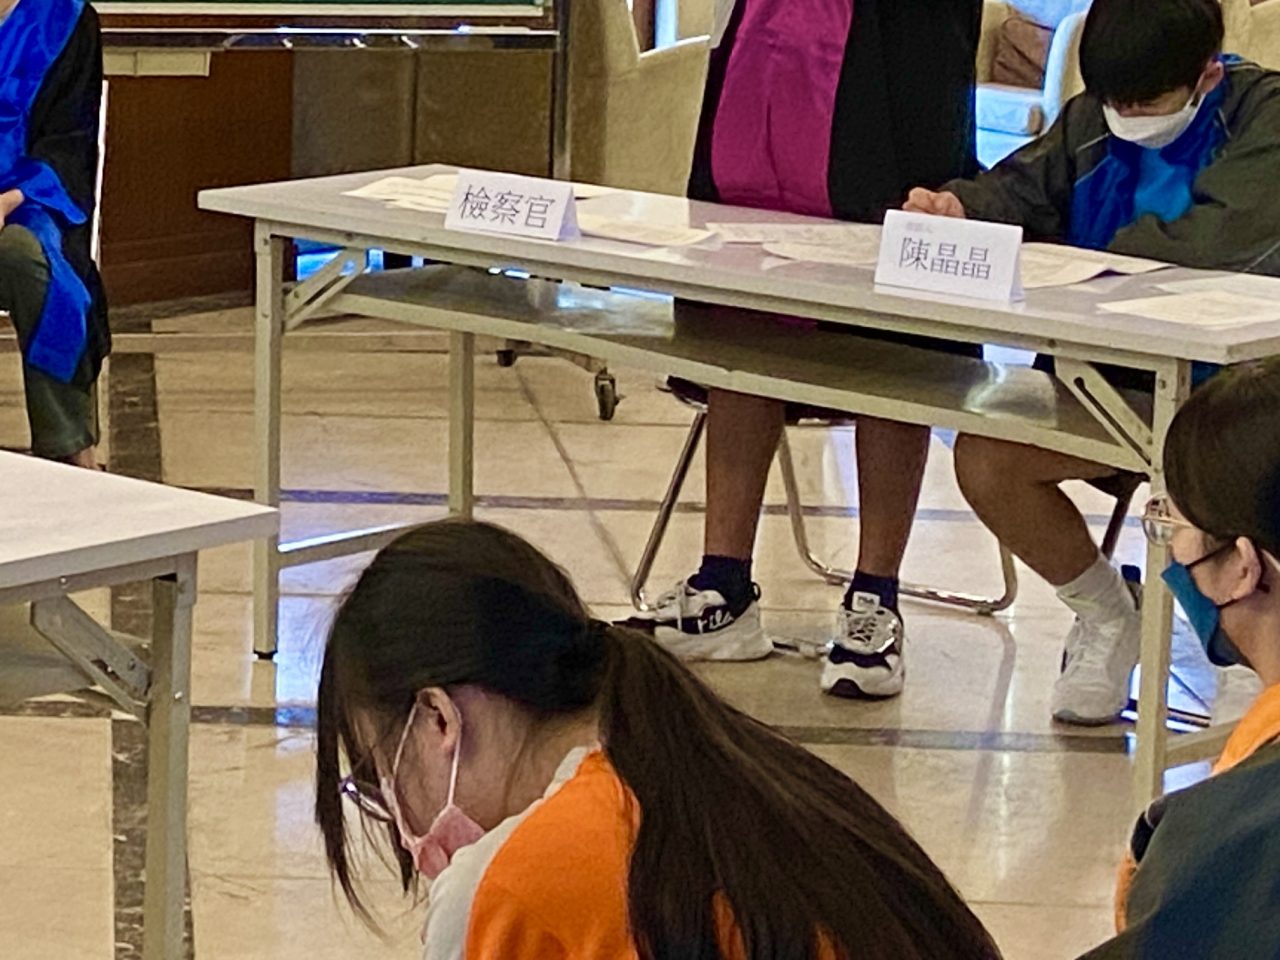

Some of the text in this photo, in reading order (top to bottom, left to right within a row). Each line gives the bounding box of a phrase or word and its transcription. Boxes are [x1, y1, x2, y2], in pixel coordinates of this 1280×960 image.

[460, 184, 556, 229] 檢察官
[899, 236, 992, 280] 陳晶晶
